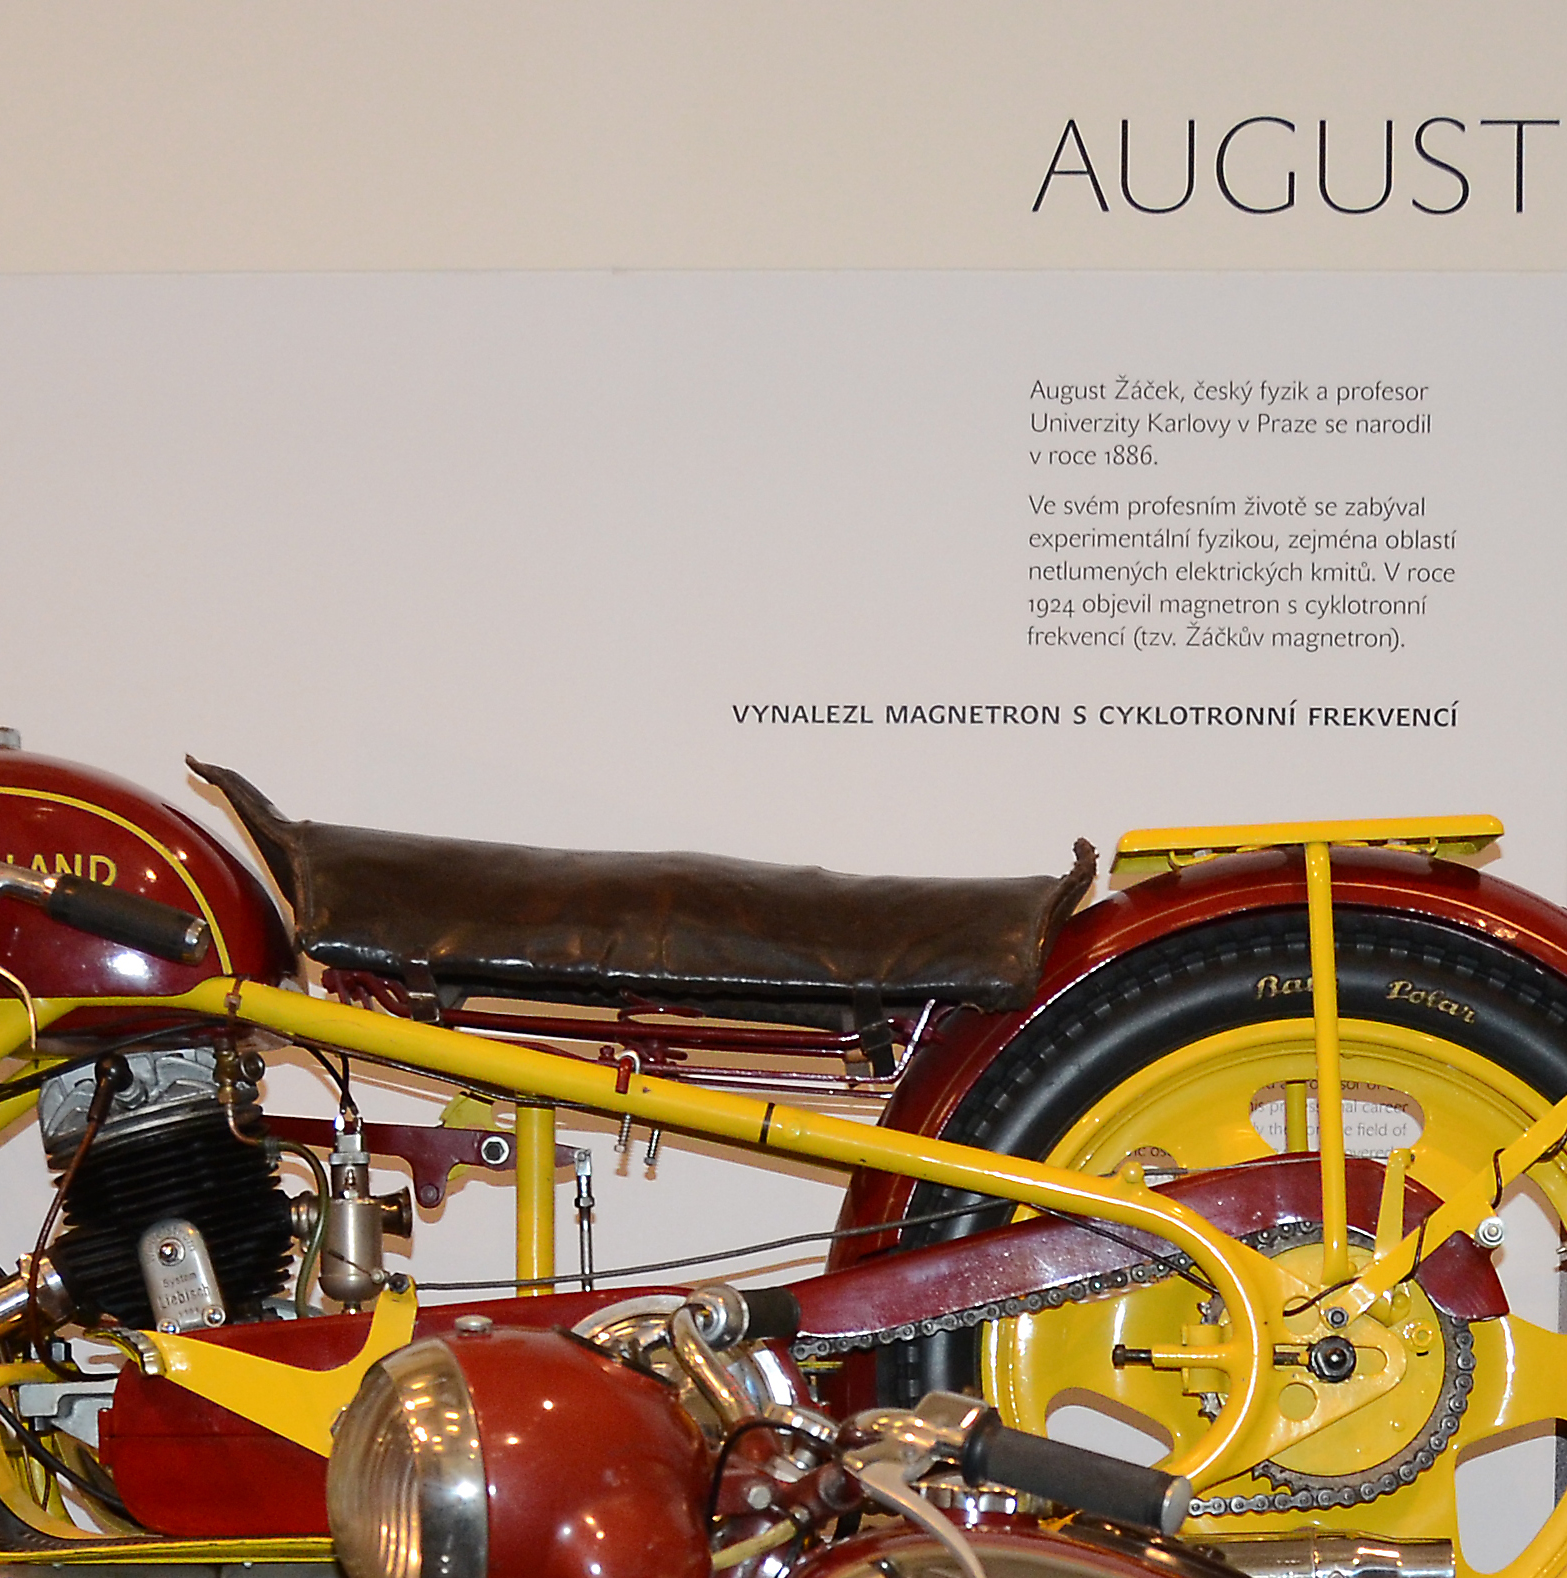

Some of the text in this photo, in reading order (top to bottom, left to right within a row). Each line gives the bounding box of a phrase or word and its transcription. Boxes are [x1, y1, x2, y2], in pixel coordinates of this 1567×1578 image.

[1031, 115, 1561, 216] AUGUST
[1029, 374, 1430, 406] August Žáček, český fyzik a profesor
[1031, 411, 1431, 439] Univerzity Karlovy v Praze se narodil
[1029, 444, 1158, 466] v roce 1886.
[1028, 494, 1425, 522] Ve svém profesním životě se zabýval
[1028, 527, 1458, 555] experimentální fyzikou, zejména oblastí
[1029, 560, 1456, 587] netlumených elektrických kmitů. V roce
[1028, 592, 1428, 620] 1924 objevil magnetron s cyklotronní
[1027, 621, 1405, 653] frekvencí (tzv. Žáčkův magnetron).
[732, 698, 1460, 728] VYNALEZL MAGNETRON S CYKLOTRONNÍ FREKVENCÍ
